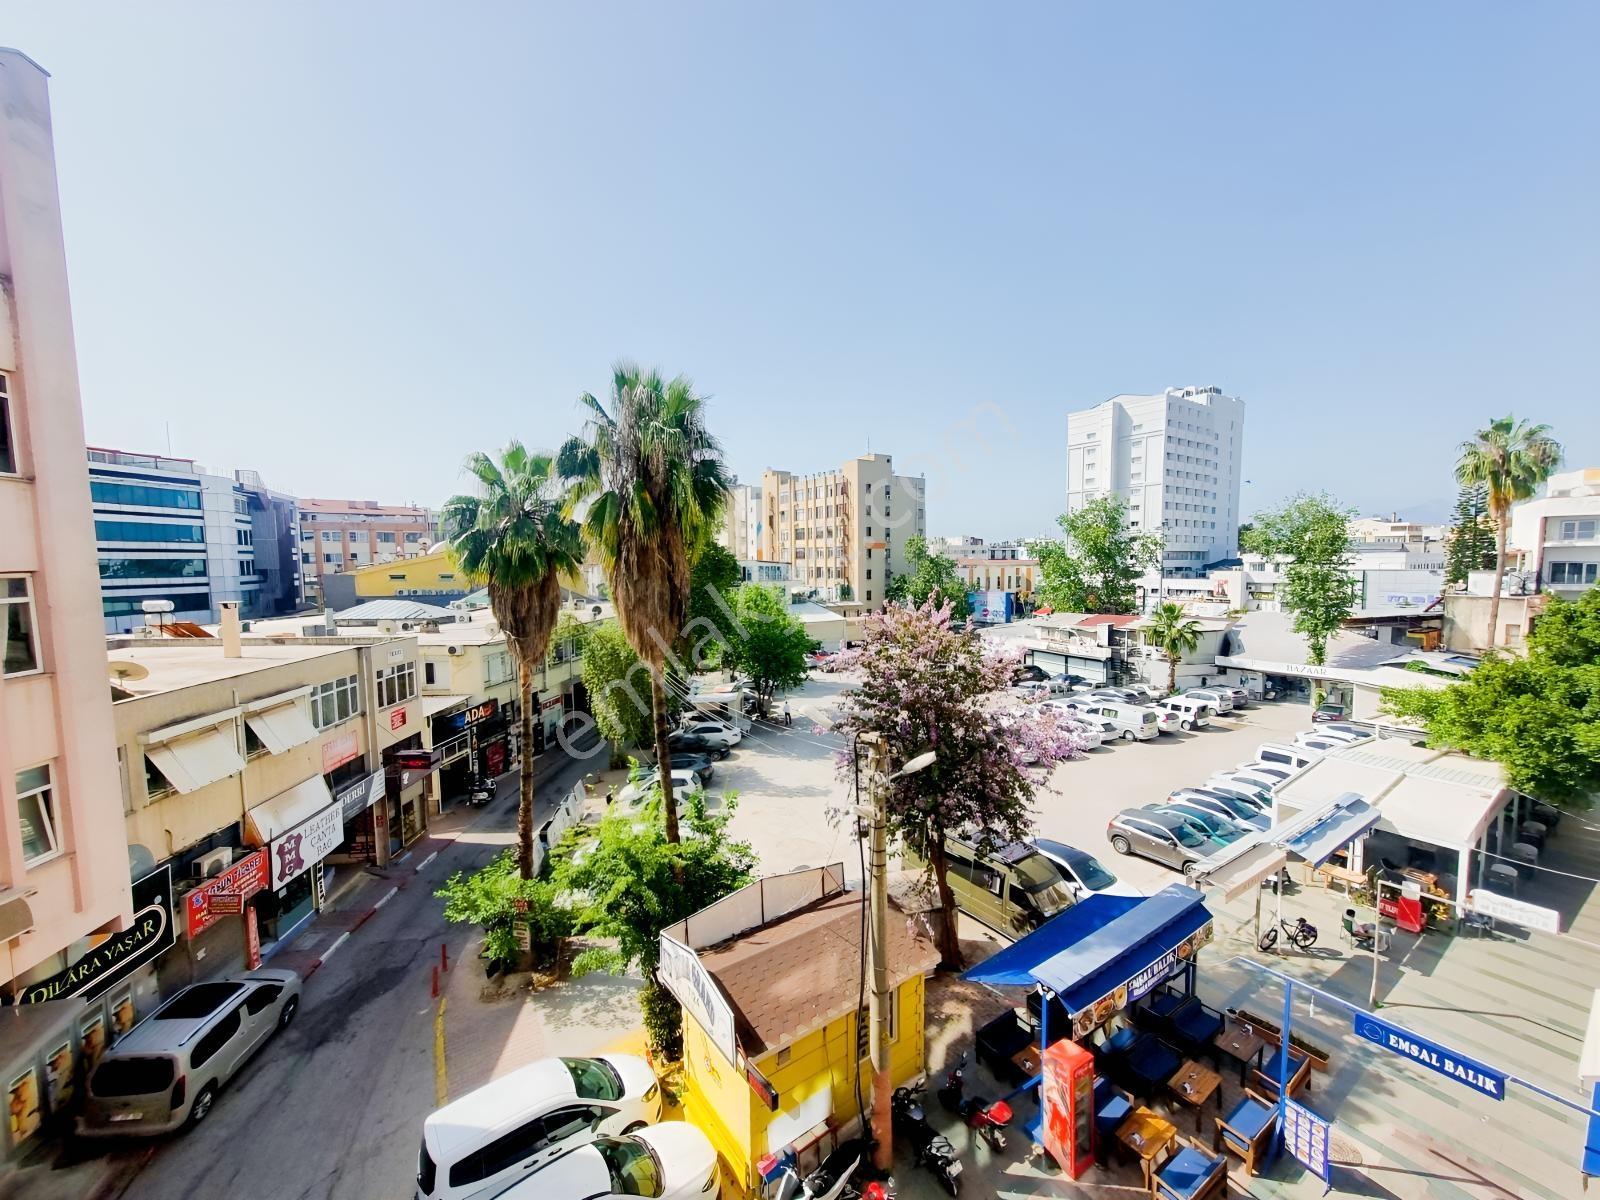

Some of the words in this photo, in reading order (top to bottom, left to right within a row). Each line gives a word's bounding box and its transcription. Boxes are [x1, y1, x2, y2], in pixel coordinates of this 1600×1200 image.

[464, 705, 485, 723] ADA
[104, 919, 155, 960] YAŞAR
[1388, 1034, 1441, 1067] EMSAL
[1443, 1058, 1498, 1094] BALIK
